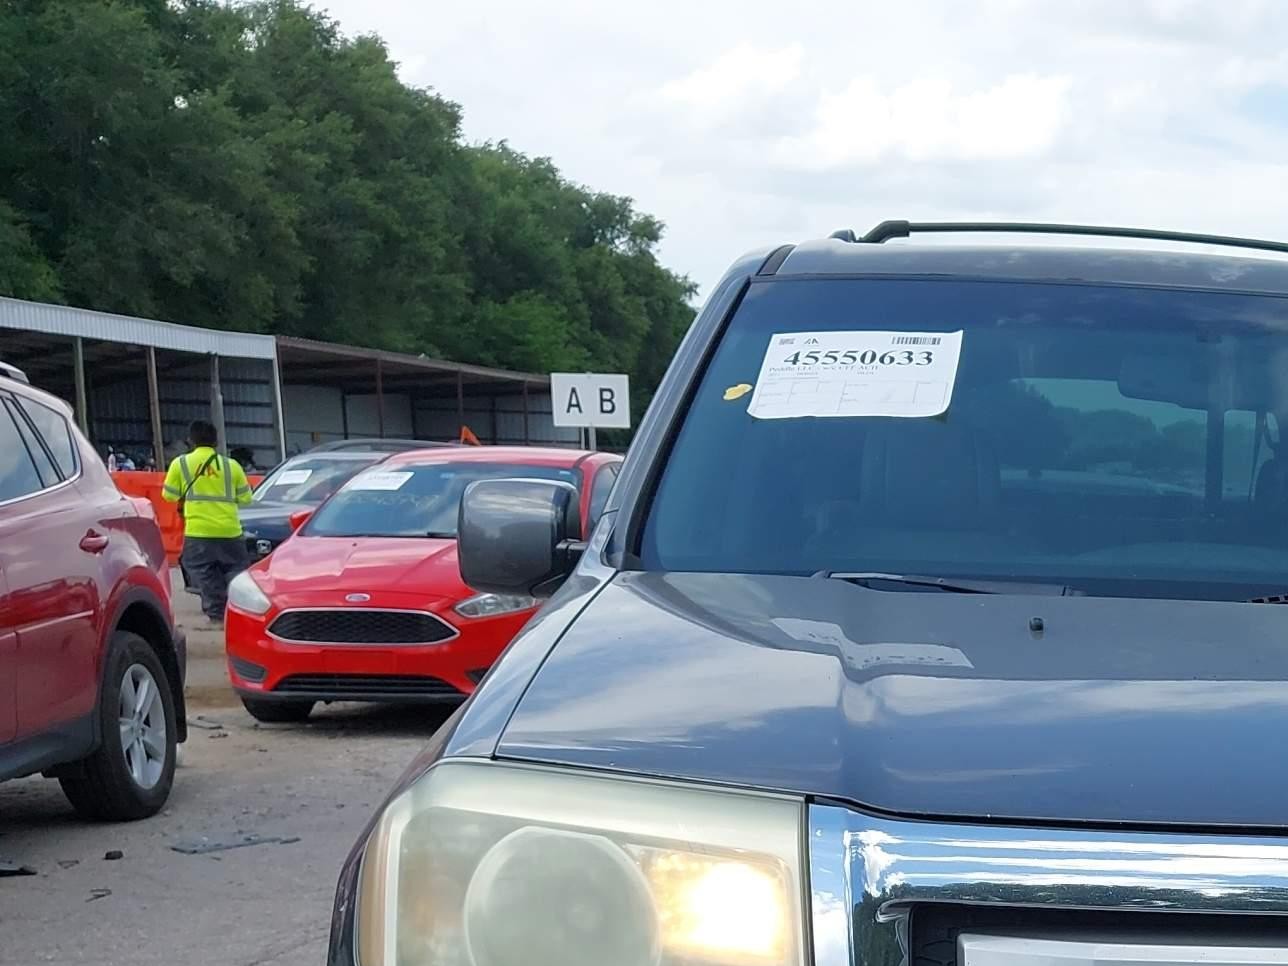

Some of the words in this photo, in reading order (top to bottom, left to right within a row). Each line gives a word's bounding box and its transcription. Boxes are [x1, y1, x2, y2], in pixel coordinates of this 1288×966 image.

[783, 349, 934, 367] 45550633
[566, 387, 583, 414] A
[599, 387, 616, 414] B
